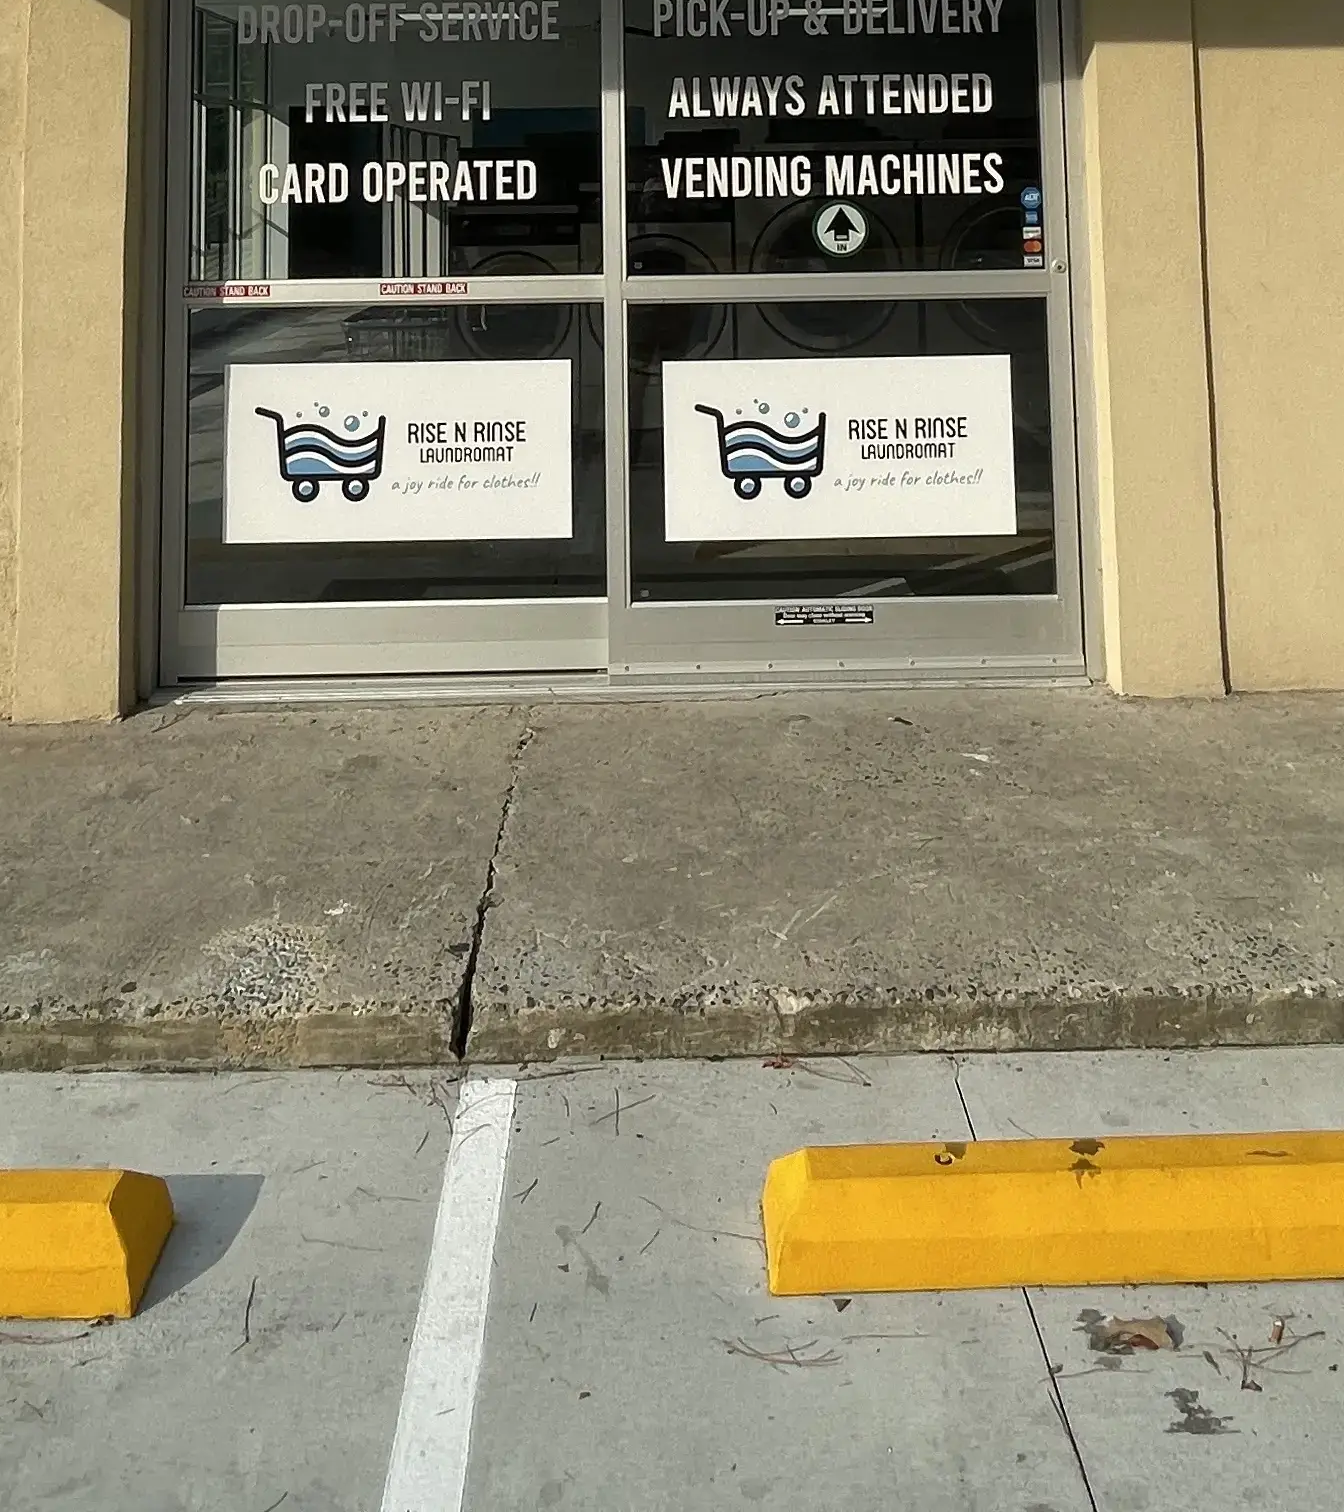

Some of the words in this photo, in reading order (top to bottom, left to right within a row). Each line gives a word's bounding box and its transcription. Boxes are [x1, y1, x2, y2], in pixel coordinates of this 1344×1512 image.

[237, 2, 406, 45] DROP-OFF
[418, 0, 560, 42] SERVICE
[304, 81, 390, 124] FREE
[400, 80, 491, 123] WI-FI
[667, 75, 806, 118] ALWAYS
[817, 72, 993, 116] ATTENDED
[258, 161, 350, 205] CARD
[362, 158, 538, 203] OPERATED
[661, 154, 812, 199] VENDING
[824, 152, 1005, 196] MACHINES
[836, 243, 848, 252] IN
[183, 287, 216, 297] CAUTION
[219, 286, 246, 296] STAND
[247, 285, 269, 296] BACK
[381, 284, 414, 294] CAUTION
[417, 283, 443, 294] STAND
[445, 282, 466, 294] BACK
[407, 422, 448, 444] RISE
[454, 421, 467, 443] N
[474, 420, 527, 443] RINSE
[848, 418, 889, 440] RISE
[895, 417, 908, 439] N
[914, 416, 968, 439] RINSE
[419, 446, 514, 464] LAUNDROMAT
[861, 442, 956, 460] LAUNDROMAT
[391, 481, 401, 490] a
[401, 476, 424, 495] joy
[427, 475, 454, 490] ride
[457, 474, 479, 491] for
[482, 471, 542, 489] clothes!!
[833, 478, 843, 487] a
[843, 473, 866, 491] joy
[870, 471, 896, 487] ride
[900, 470, 922, 487] for
[925, 468, 984, 485] clothes!!
